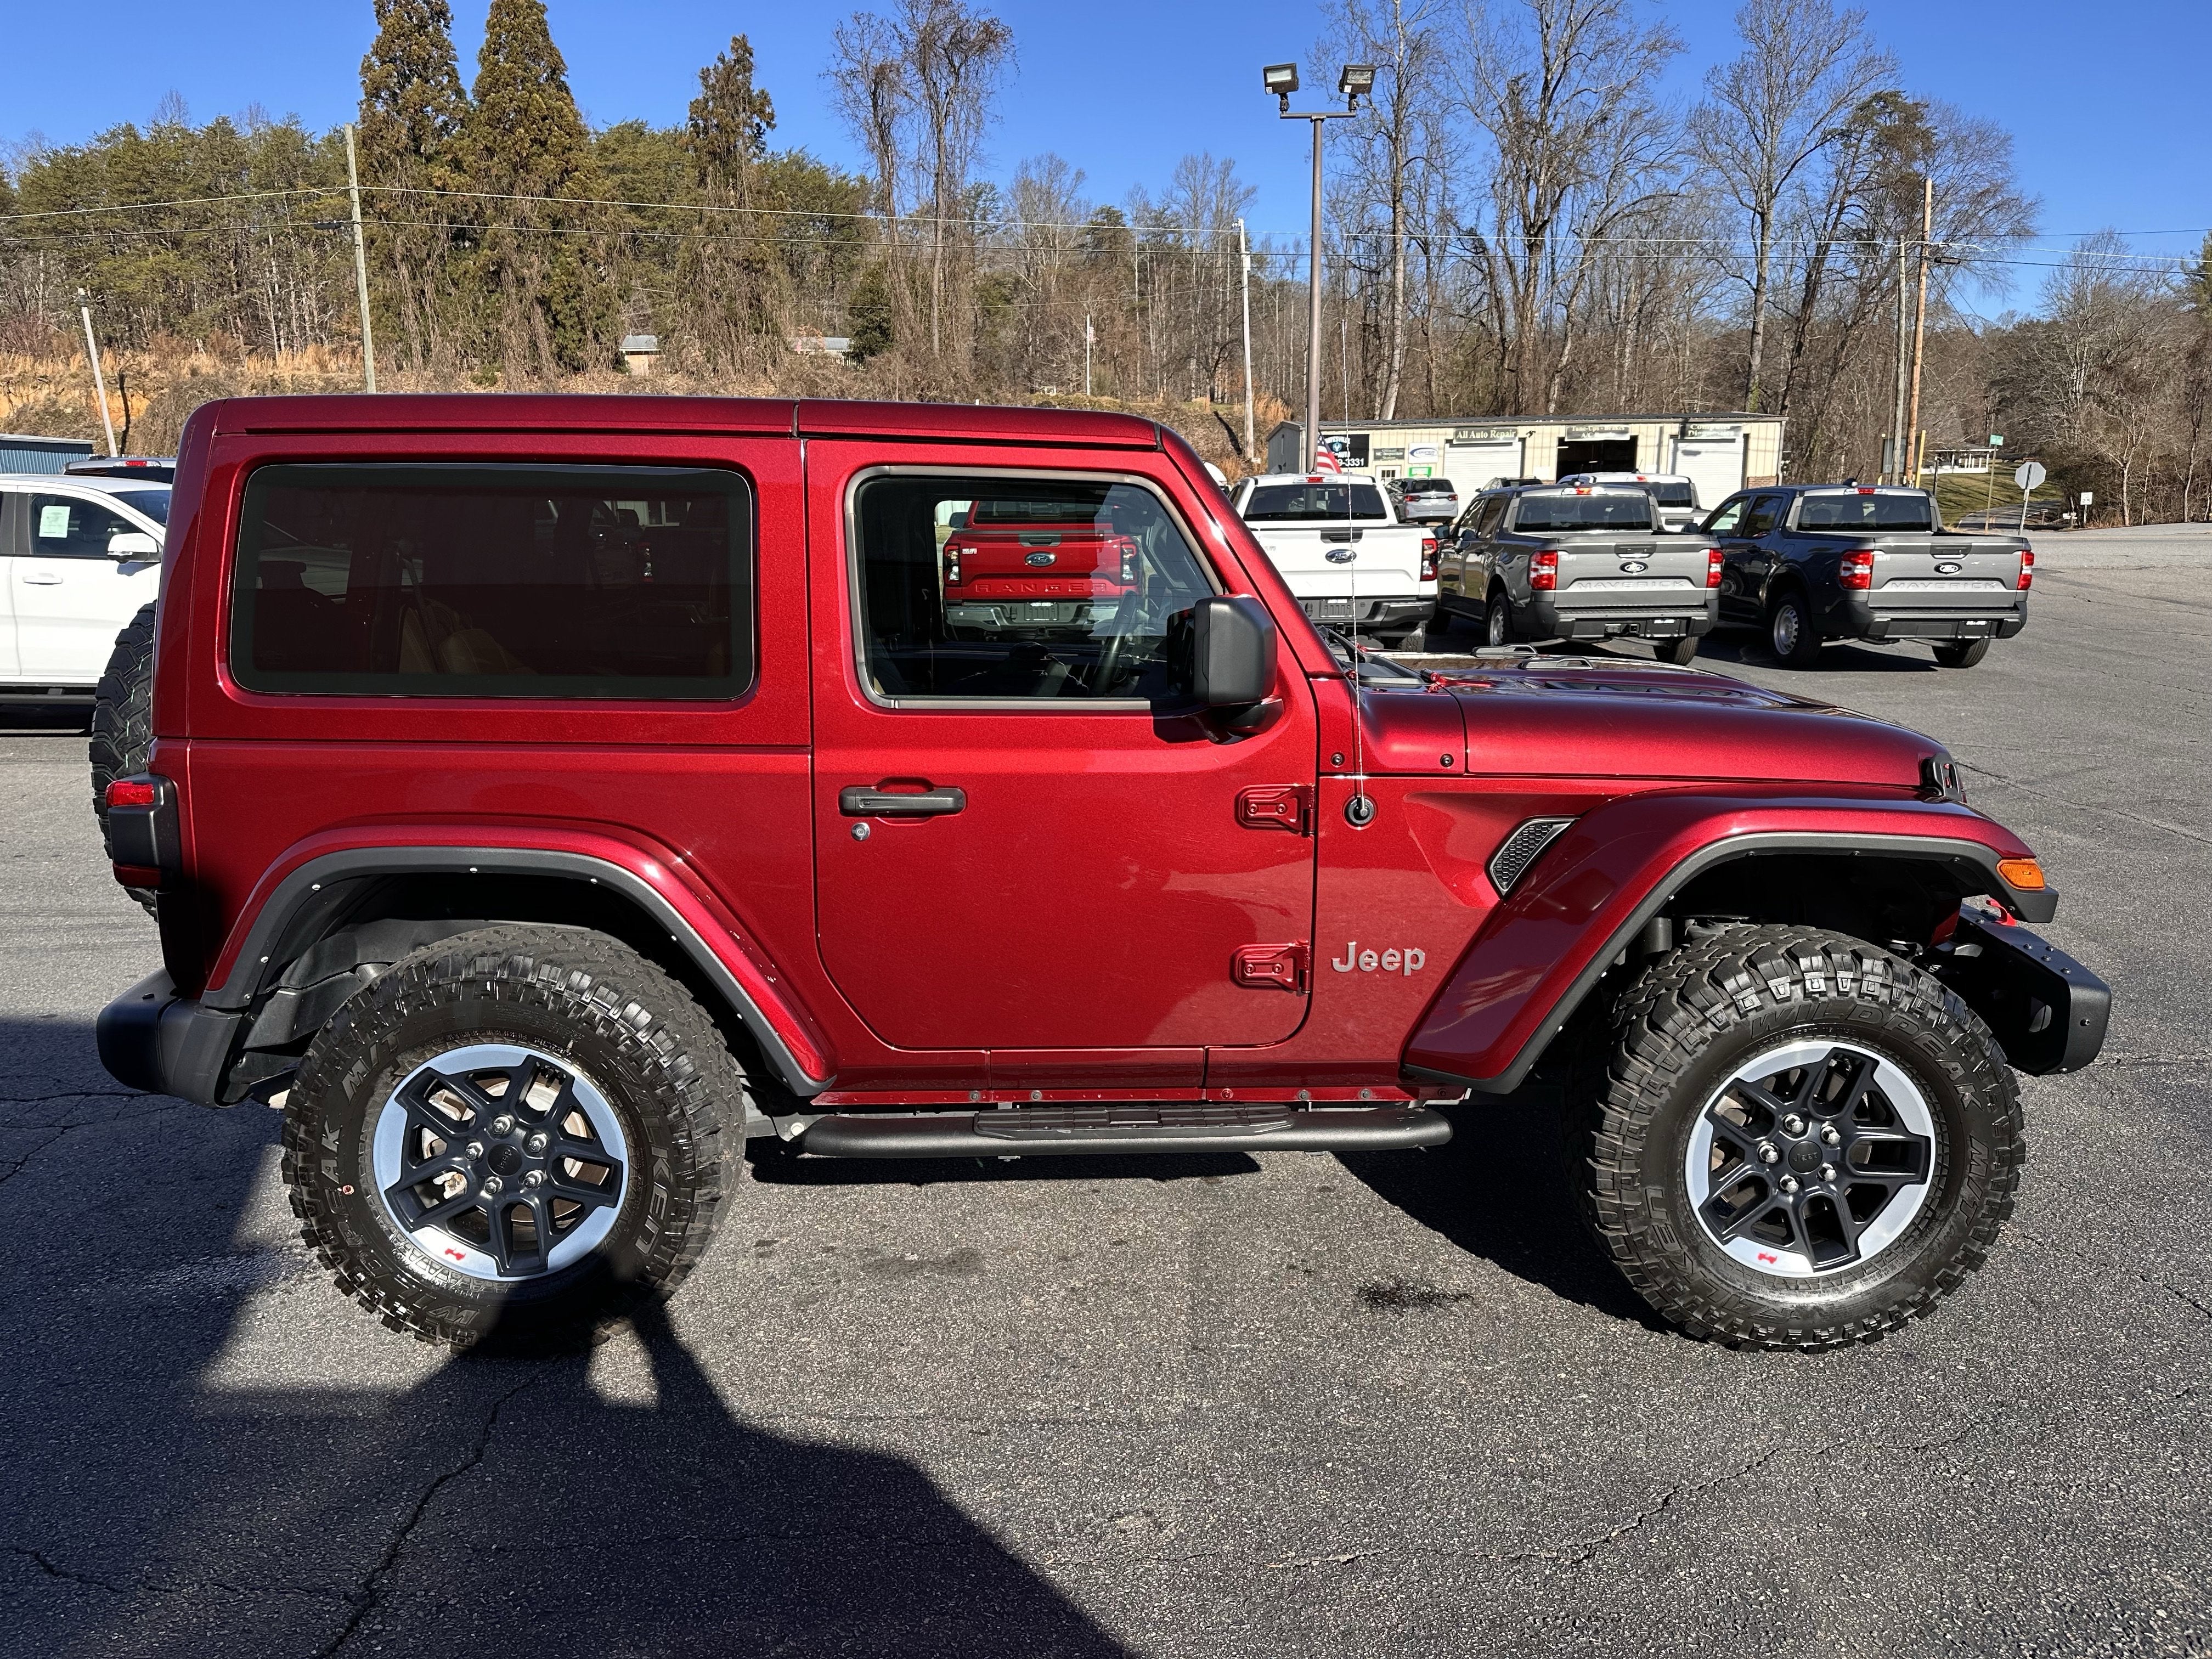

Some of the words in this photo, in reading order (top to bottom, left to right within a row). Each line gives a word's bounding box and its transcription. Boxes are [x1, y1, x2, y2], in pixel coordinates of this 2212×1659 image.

[1456, 430, 1468, 439] All
[1469, 430, 1488, 439] Auto
[1490, 429, 1516, 440] Repair
[1337, 458, 1364, 467] 9-3331
[975, 583, 1107, 593] RANGER
[1577, 580, 1686, 590] MAVERICK
[1891, 582, 1997, 590] MAVERICK
[1331, 941, 1426, 977] Jeep
[1750, 1002, 1984, 1112] WILDPEAK
